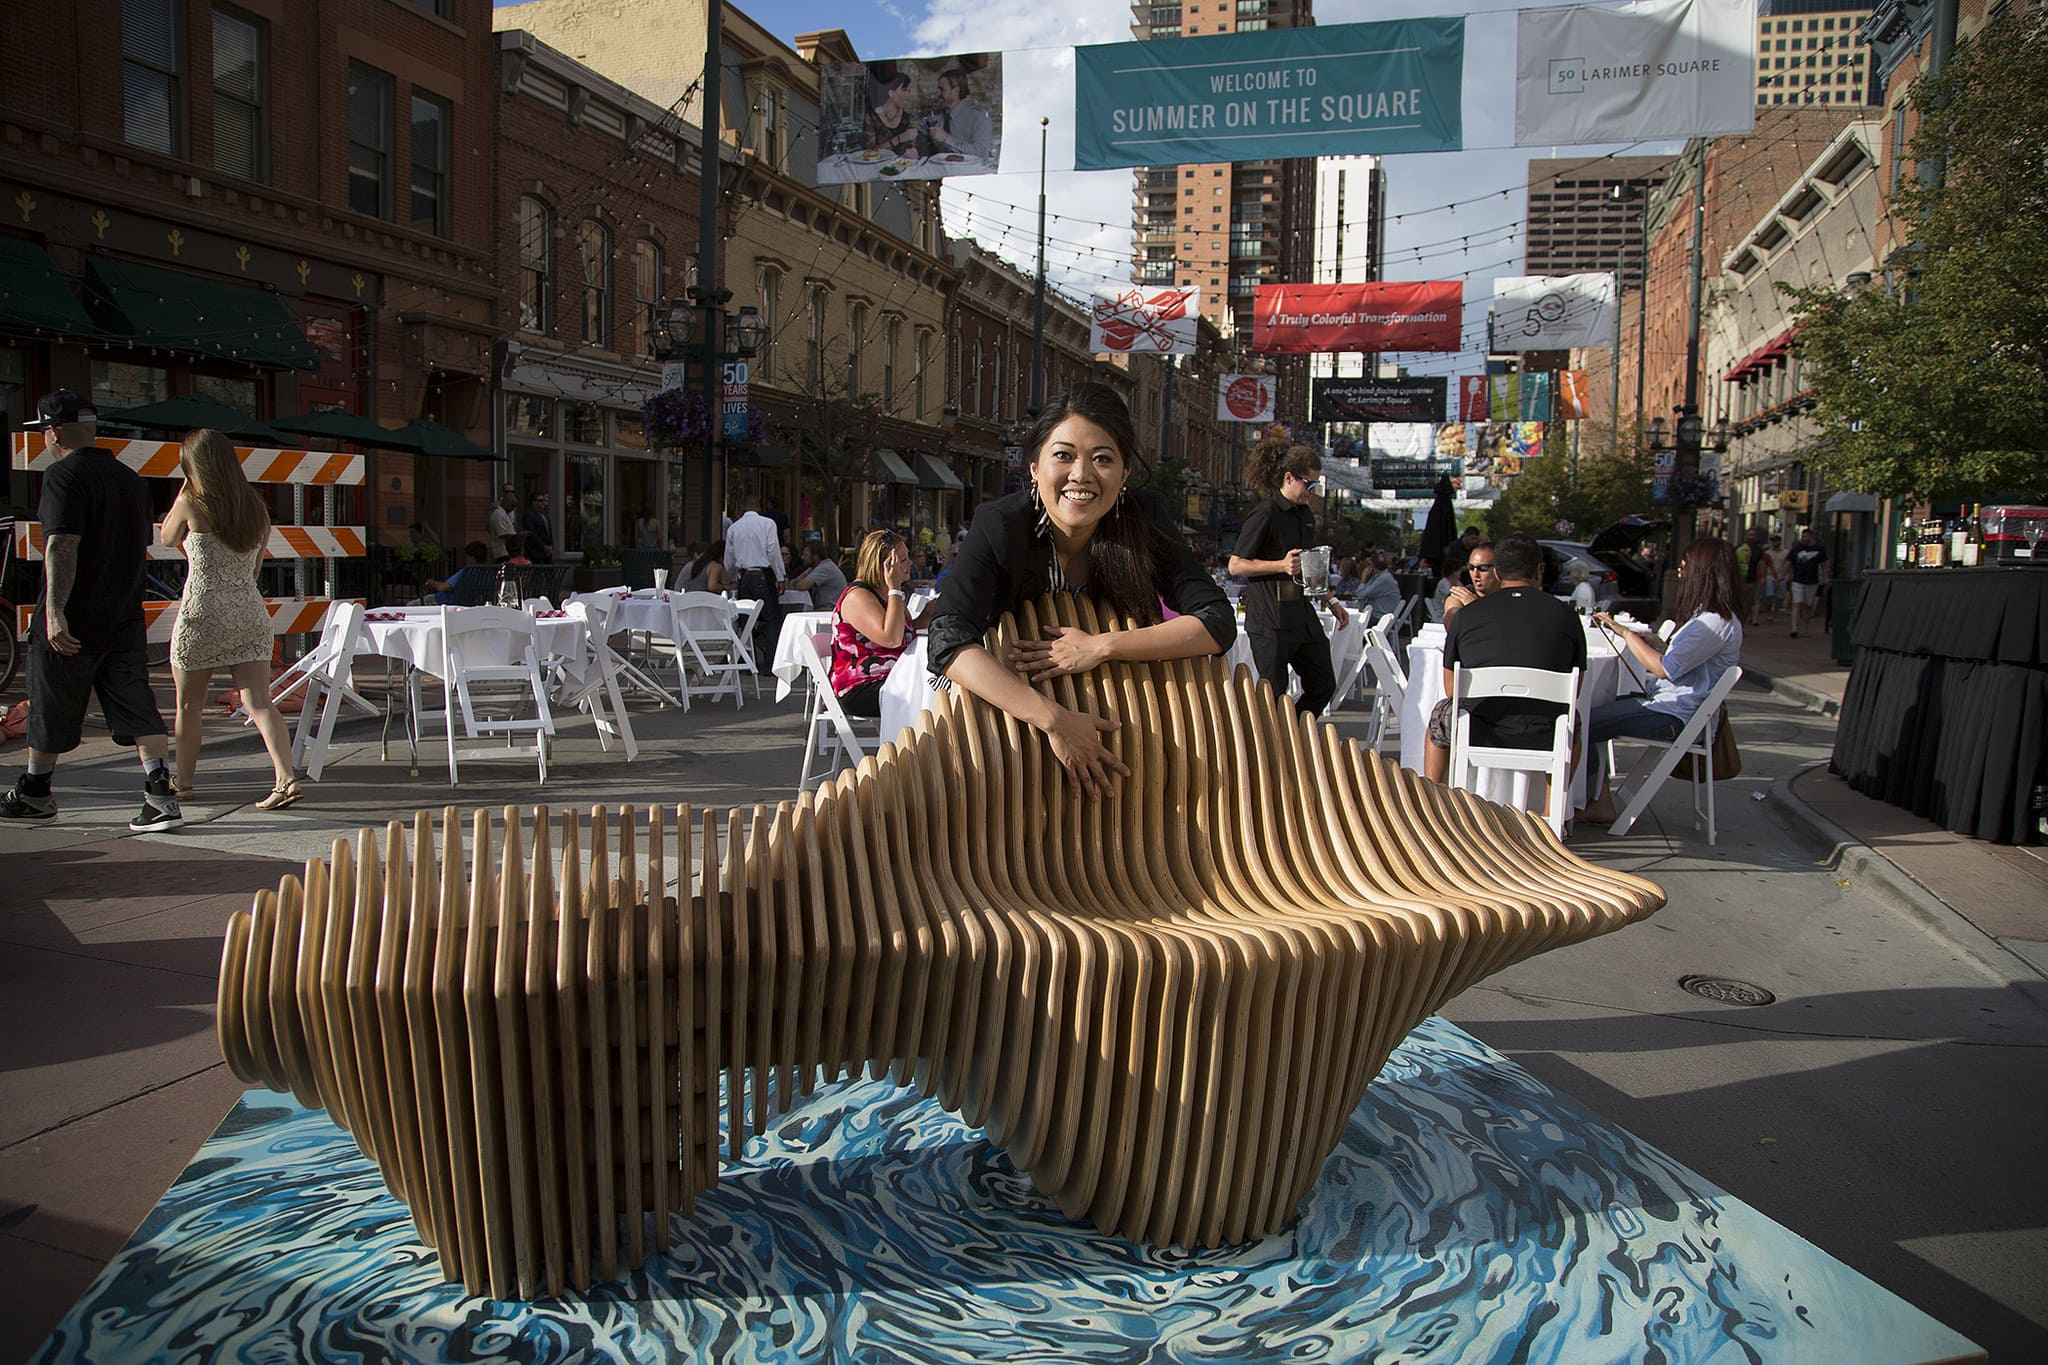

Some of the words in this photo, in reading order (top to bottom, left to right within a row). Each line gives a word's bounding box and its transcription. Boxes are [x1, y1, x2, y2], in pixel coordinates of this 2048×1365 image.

[1558, 70, 1575, 84] 50
[1582, 63, 1650, 81] LARIMER
[1656, 59, 1720, 77] SQUARE
[1210, 70, 1290, 93] WELCOME
[1297, 68, 1317, 87] TO
[1112, 103, 1215, 134] SUMMER
[1226, 100, 1257, 128] ON
[1267, 96, 1311, 125] THE
[1321, 88, 1421, 123] SQUARE
[1268, 314, 1277, 326] A
[1279, 314, 1309, 327] Truly
[1312, 313, 1356, 326] Colorful
[1359, 312, 1447, 326] Transformation
[723, 362, 748, 385] 50
[723, 384, 748, 395] YEARS
[723, 402, 748, 414] LIVES
[1008, 450, 1023, 462] 50
[1654, 452, 1674, 467] 50
